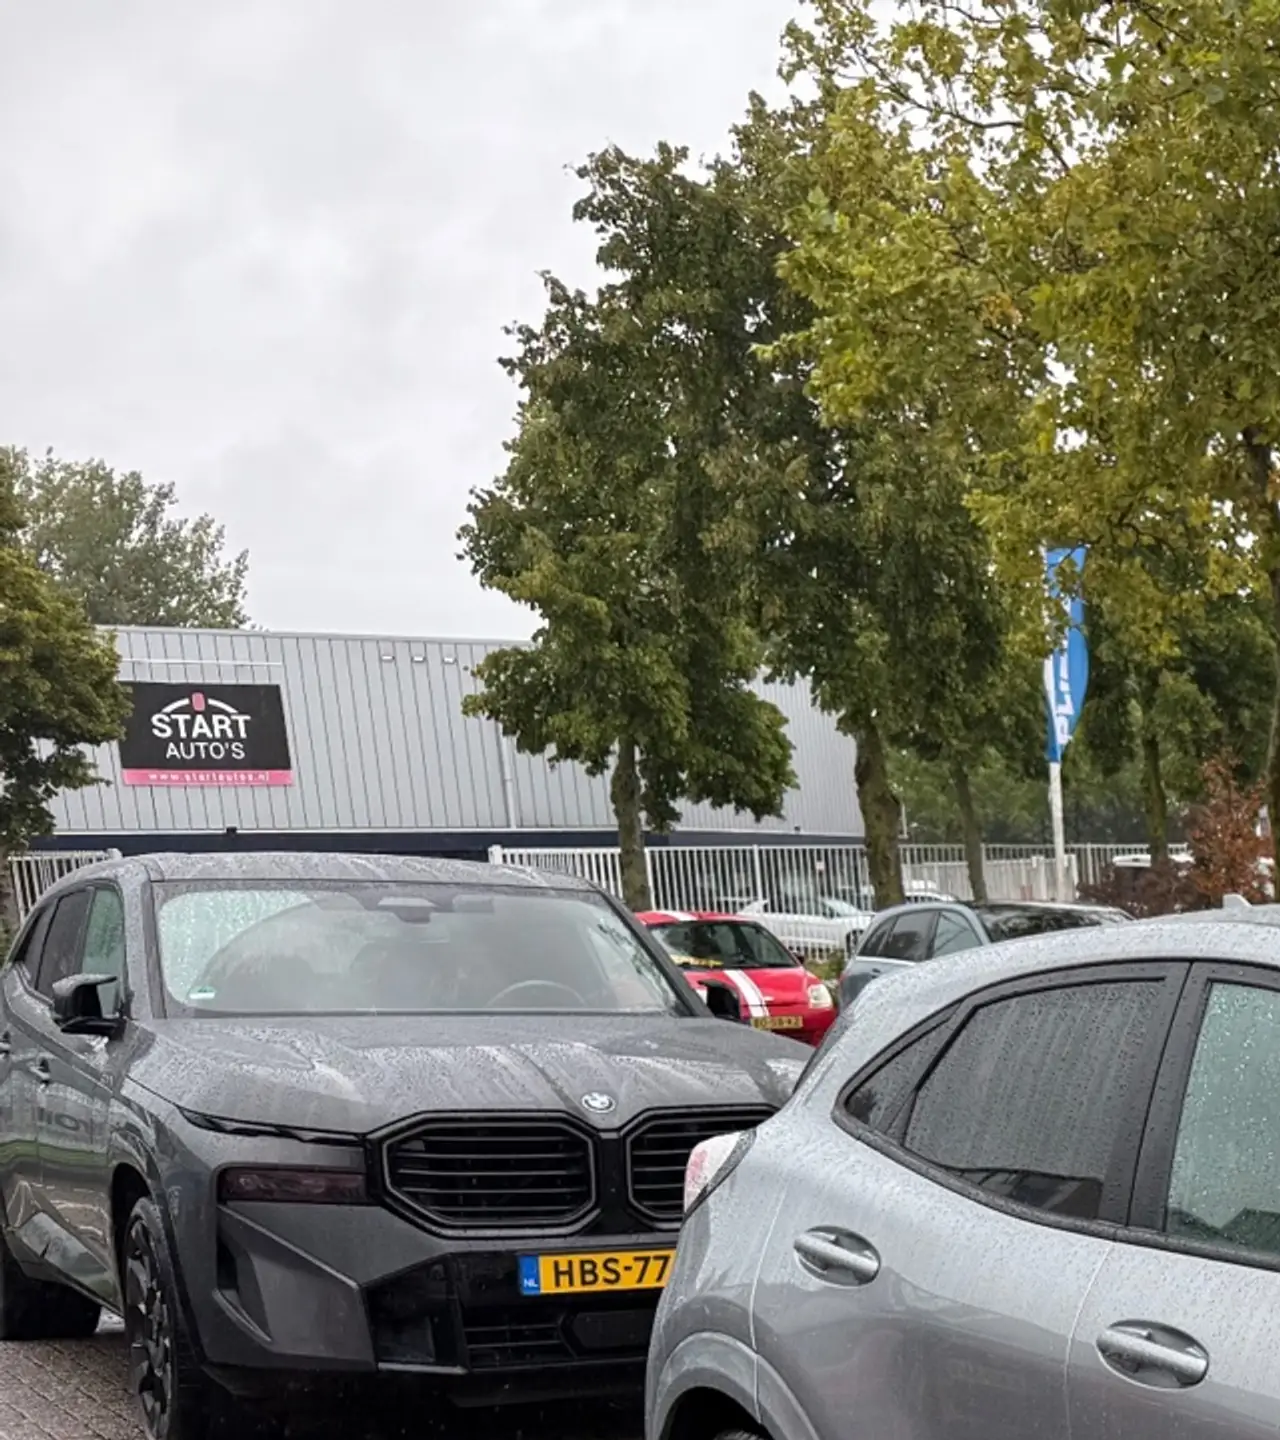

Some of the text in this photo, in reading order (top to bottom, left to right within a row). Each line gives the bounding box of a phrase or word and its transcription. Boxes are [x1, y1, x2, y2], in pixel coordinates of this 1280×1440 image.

[151, 714, 251, 739] START
[166, 742, 245, 760] AUTO'S
[553, 1254, 671, 1289] HBS-77
